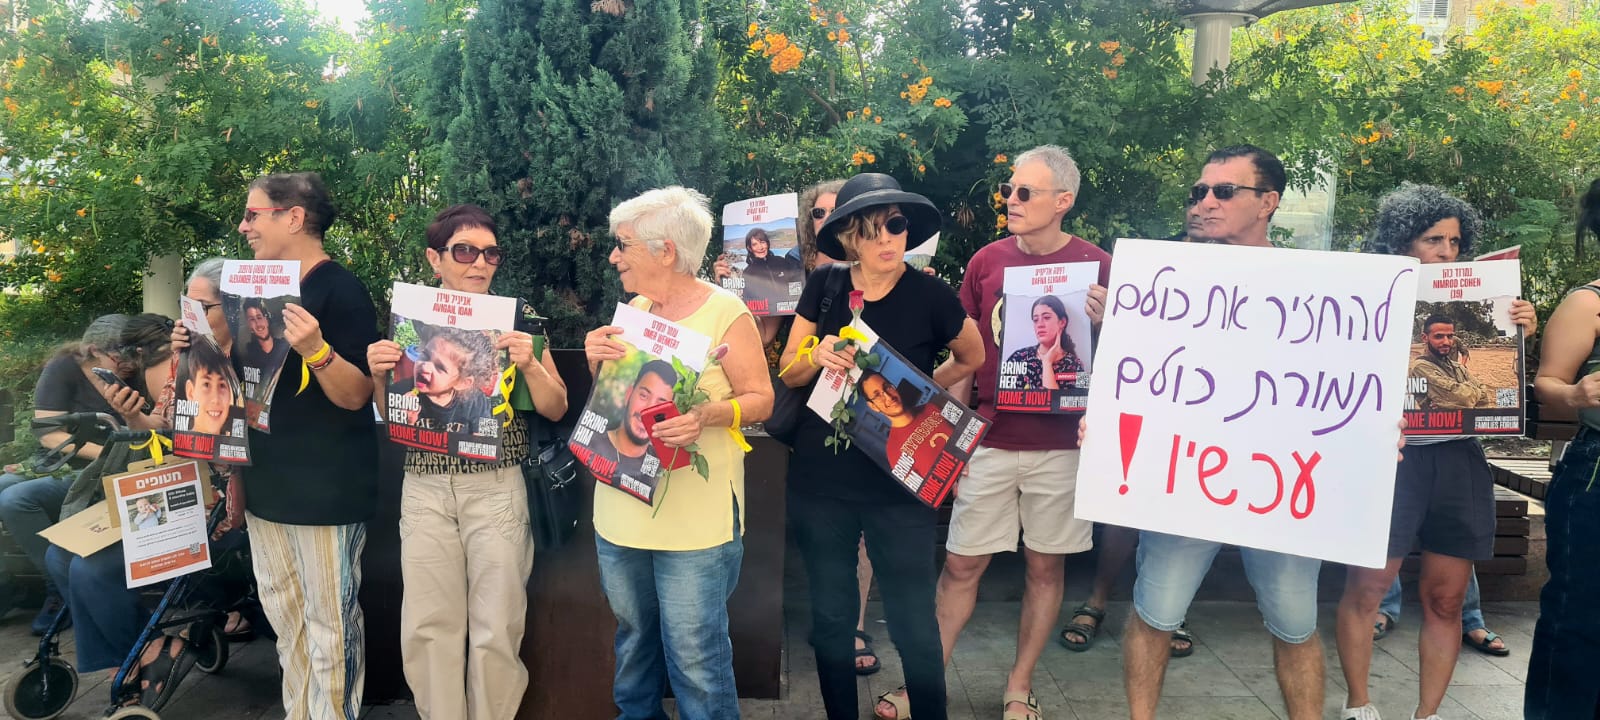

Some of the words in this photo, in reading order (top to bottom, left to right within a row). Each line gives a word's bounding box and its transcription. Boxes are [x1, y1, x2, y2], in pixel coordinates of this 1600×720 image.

[723, 279, 745, 289] BRING
[1433, 279, 1458, 288] NIMROD
[1460, 278, 1481, 287] COHEN
[1112, 266, 1190, 320] כולם
[433, 303, 456, 314] AVIGAIL
[1193, 285, 1249, 331] את
[1266, 268, 1413, 343] להחזיר
[244, 366, 260, 383] BRING
[1001, 361, 1027, 375] BRING
[1116, 346, 1216, 405] כולם
[1000, 375, 1016, 389] HER
[388, 392, 419, 411] BRING
[998, 391, 1023, 404] HOME
[1025, 389, 1052, 405] NOW!
[1224, 370, 1382, 436] תמורת
[176, 399, 199, 416] BRING
[388, 408, 408, 424] HER
[175, 415, 189, 431] HIM
[581, 410, 608, 434] BRING
[1428, 410, 1463, 428] NOW!
[174, 433, 193, 450] HOME
[195, 436, 214, 453] NOW!
[389, 424, 416, 441] HOME
[419, 429, 448, 449] NOW!
[574, 425, 593, 446] HIM
[569, 442, 593, 466] HOME
[590, 455, 618, 478] NOW!
[891, 451, 915, 481] BRING
[136, 471, 182, 489] חטופים
[904, 469, 924, 493] HIM
[919, 475, 944, 504] HOME
[933, 450, 958, 481] NOW!
